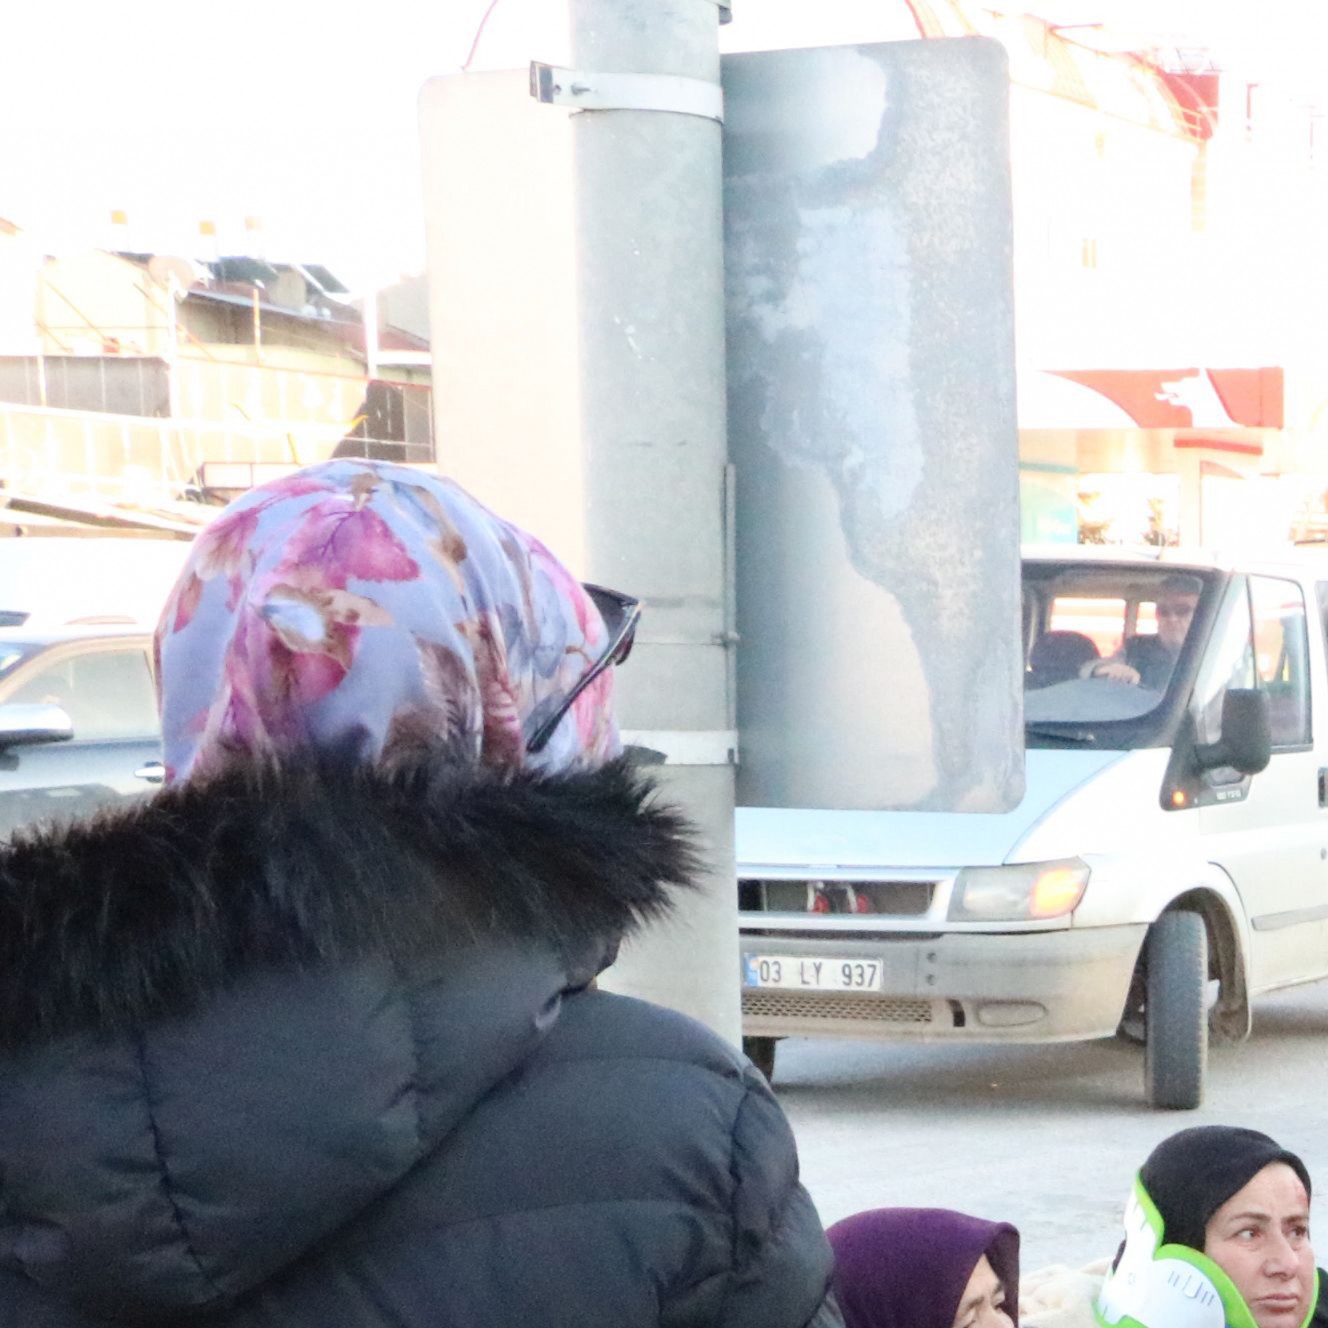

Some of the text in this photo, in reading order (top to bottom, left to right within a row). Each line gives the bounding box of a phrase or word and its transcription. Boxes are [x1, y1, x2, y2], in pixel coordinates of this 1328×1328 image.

[760, 960, 877, 988] 03 LY 937
